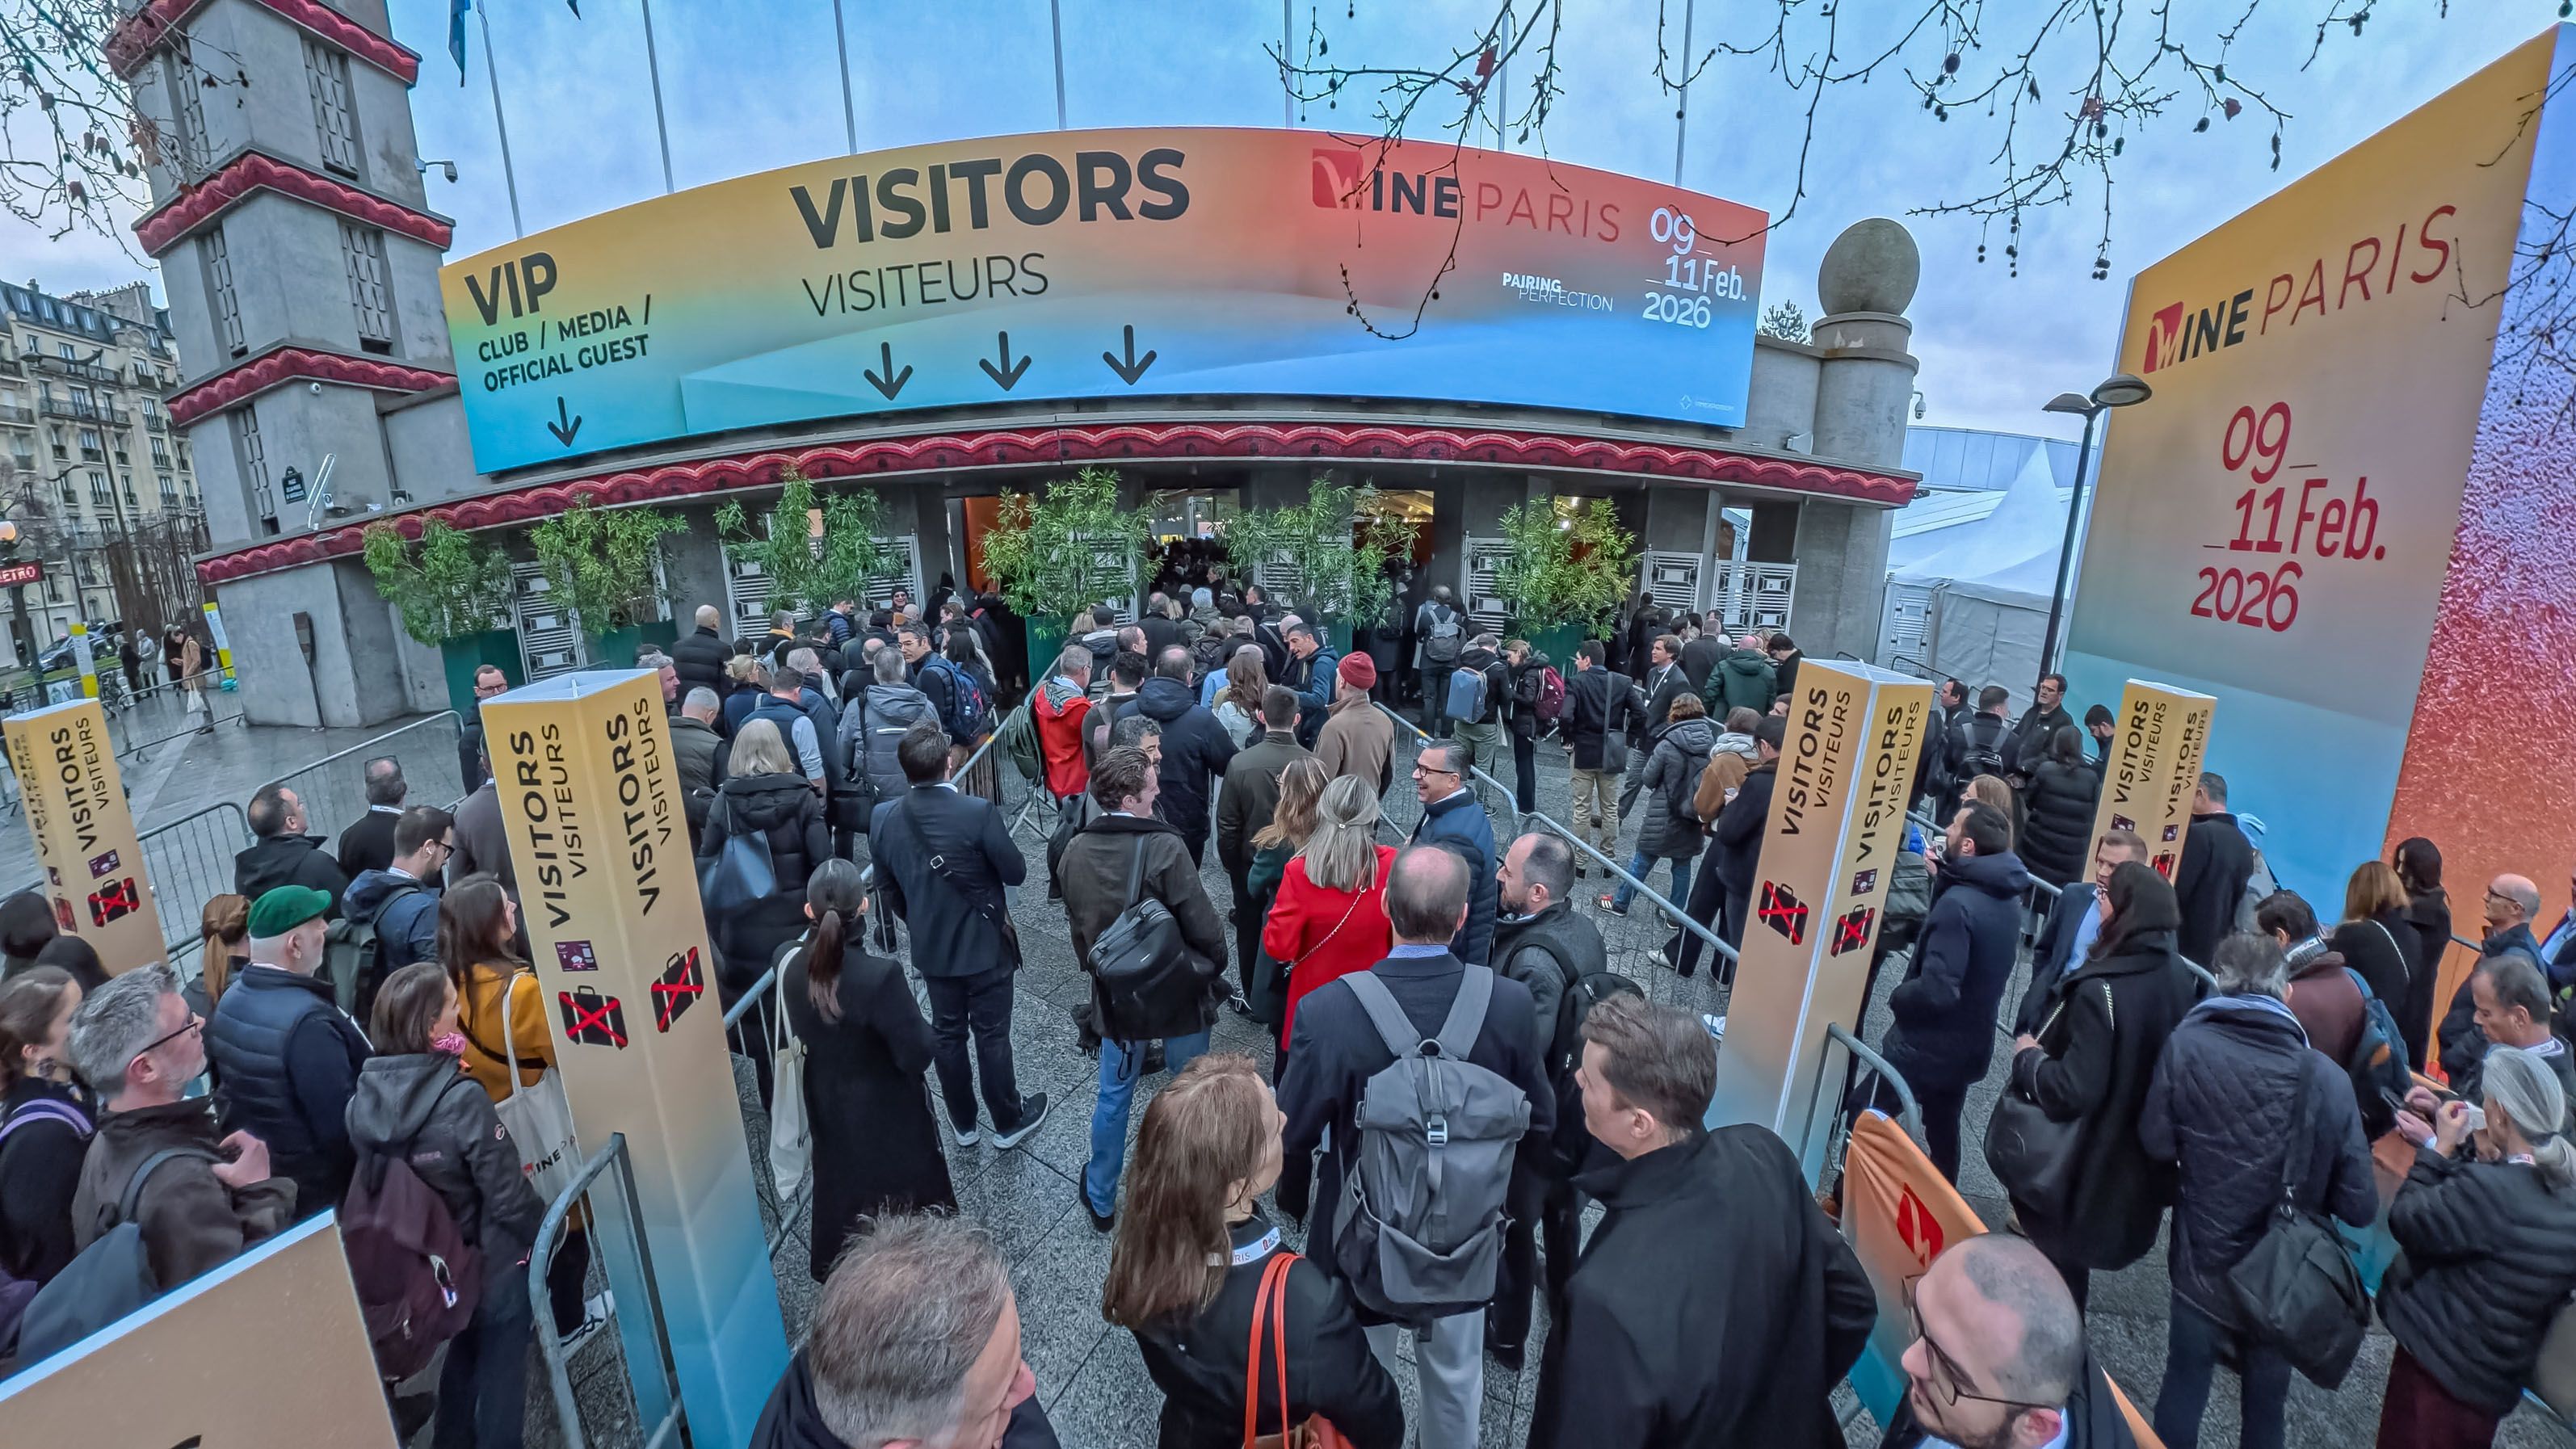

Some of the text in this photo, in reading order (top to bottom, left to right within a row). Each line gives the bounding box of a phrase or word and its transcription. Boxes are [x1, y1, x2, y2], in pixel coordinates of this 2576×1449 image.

[789, 149, 1191, 249] VISITORS
[1477, 182, 1620, 242] PARIS
[464, 252, 558, 326] VIP
[801, 252, 1049, 317] VISITEURS
[1502, 272, 1561, 293] PAIRING
[1519, 288, 1614, 312] PERFECTION
[1642, 292, 1712, 329] 2026
[2260, 204, 2456, 335] PARIS
[478, 331, 529, 362] CLUB
[558, 304, 632, 342] MEDIA
[484, 334, 649, 392] OFFICIAL GUEST
[0, 566, 36, 582] ETRO
[2191, 561, 2303, 632] 2026
[51, 728, 97, 853] VISITORS
[75, 717, 110, 811] VISITEURS
[633, 697, 673, 847] VISITEURS
[1780, 687, 1828, 837] VISITORS
[1813, 690, 1851, 809] VISITEURS
[1855, 706, 1903, 863] VISITORS
[1885, 700, 1920, 820] VISITEURS
[2114, 700, 2149, 803] VISITORS
[2139, 702, 2166, 783] VISITEURS
[2165, 712, 2198, 819] VISITORS
[2183, 709, 2208, 790] VISITEURS
[510, 730, 571, 930] VISITORS
[541, 723, 588, 879] VISITEURS
[607, 713, 662, 917] VISITORS
